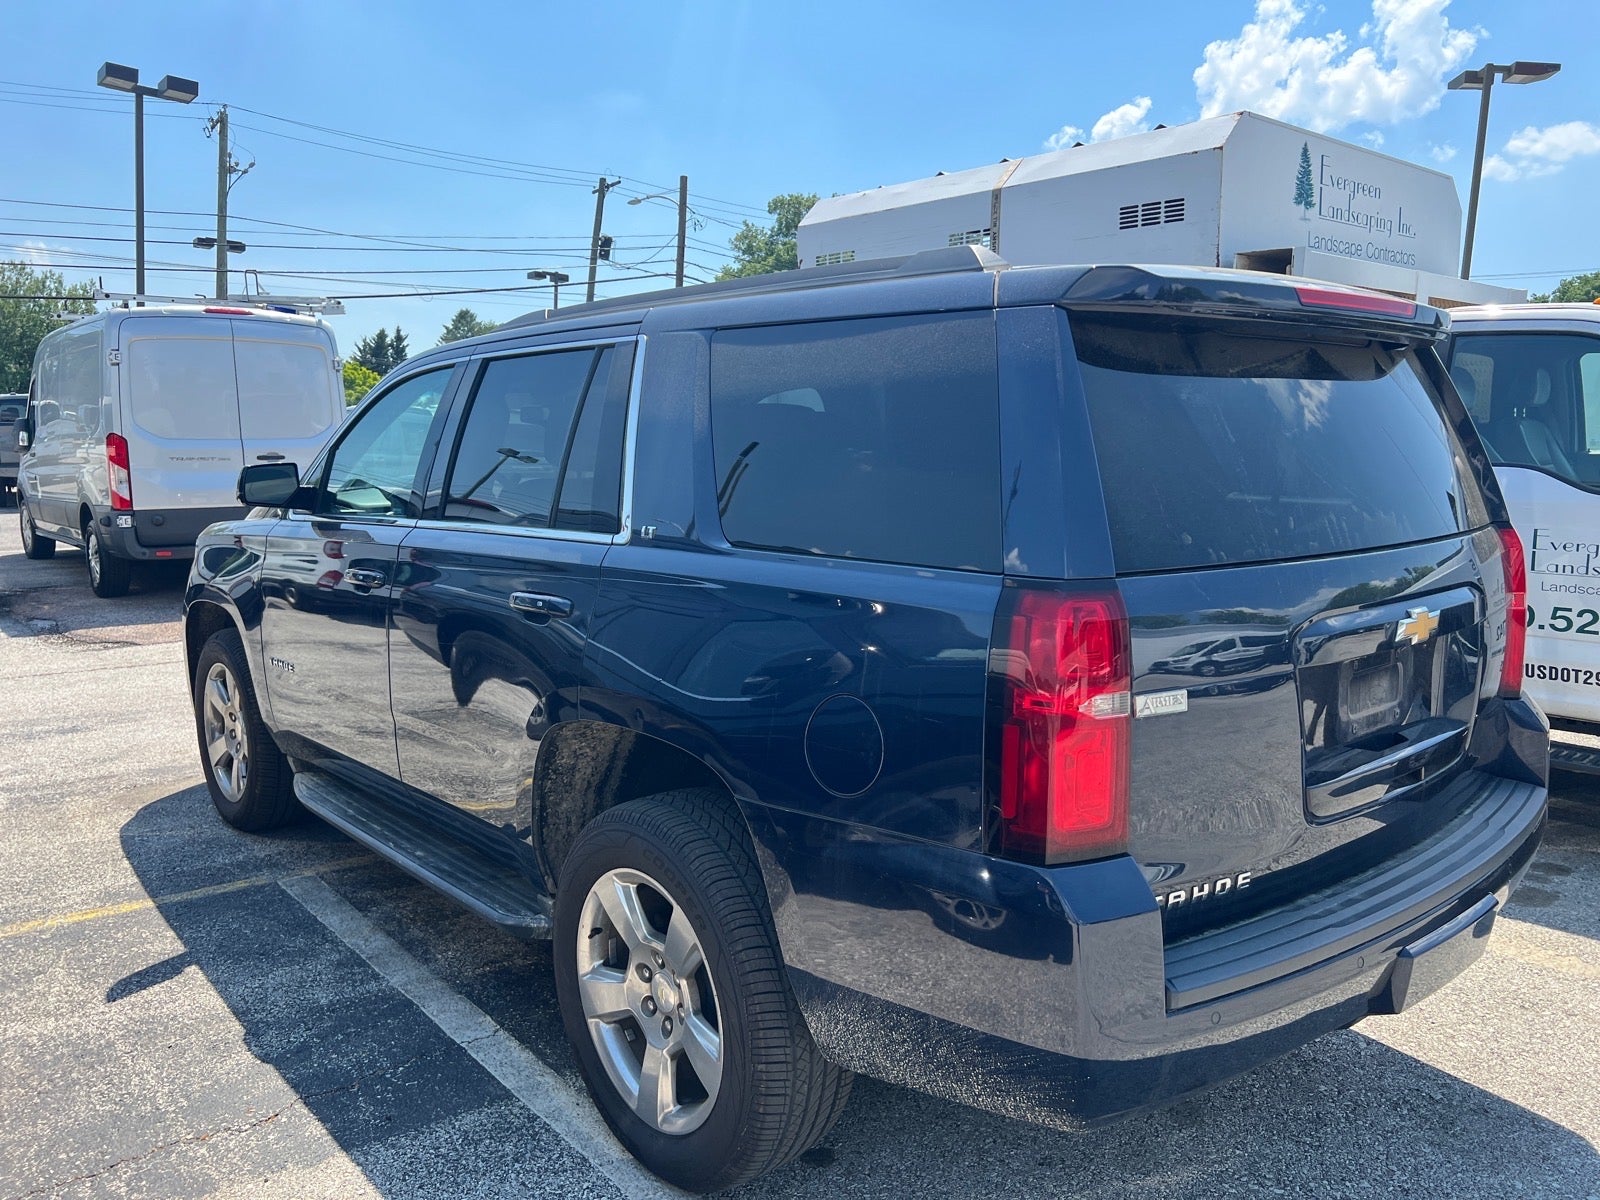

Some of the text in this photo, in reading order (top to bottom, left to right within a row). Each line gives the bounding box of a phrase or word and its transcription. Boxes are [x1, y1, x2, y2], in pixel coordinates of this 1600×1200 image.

[1320, 154, 1382, 200] Evergreen
[1319, 186, 1417, 239] Landscaping Inc.
[1307, 230, 1416, 266] Landscape Contractors
